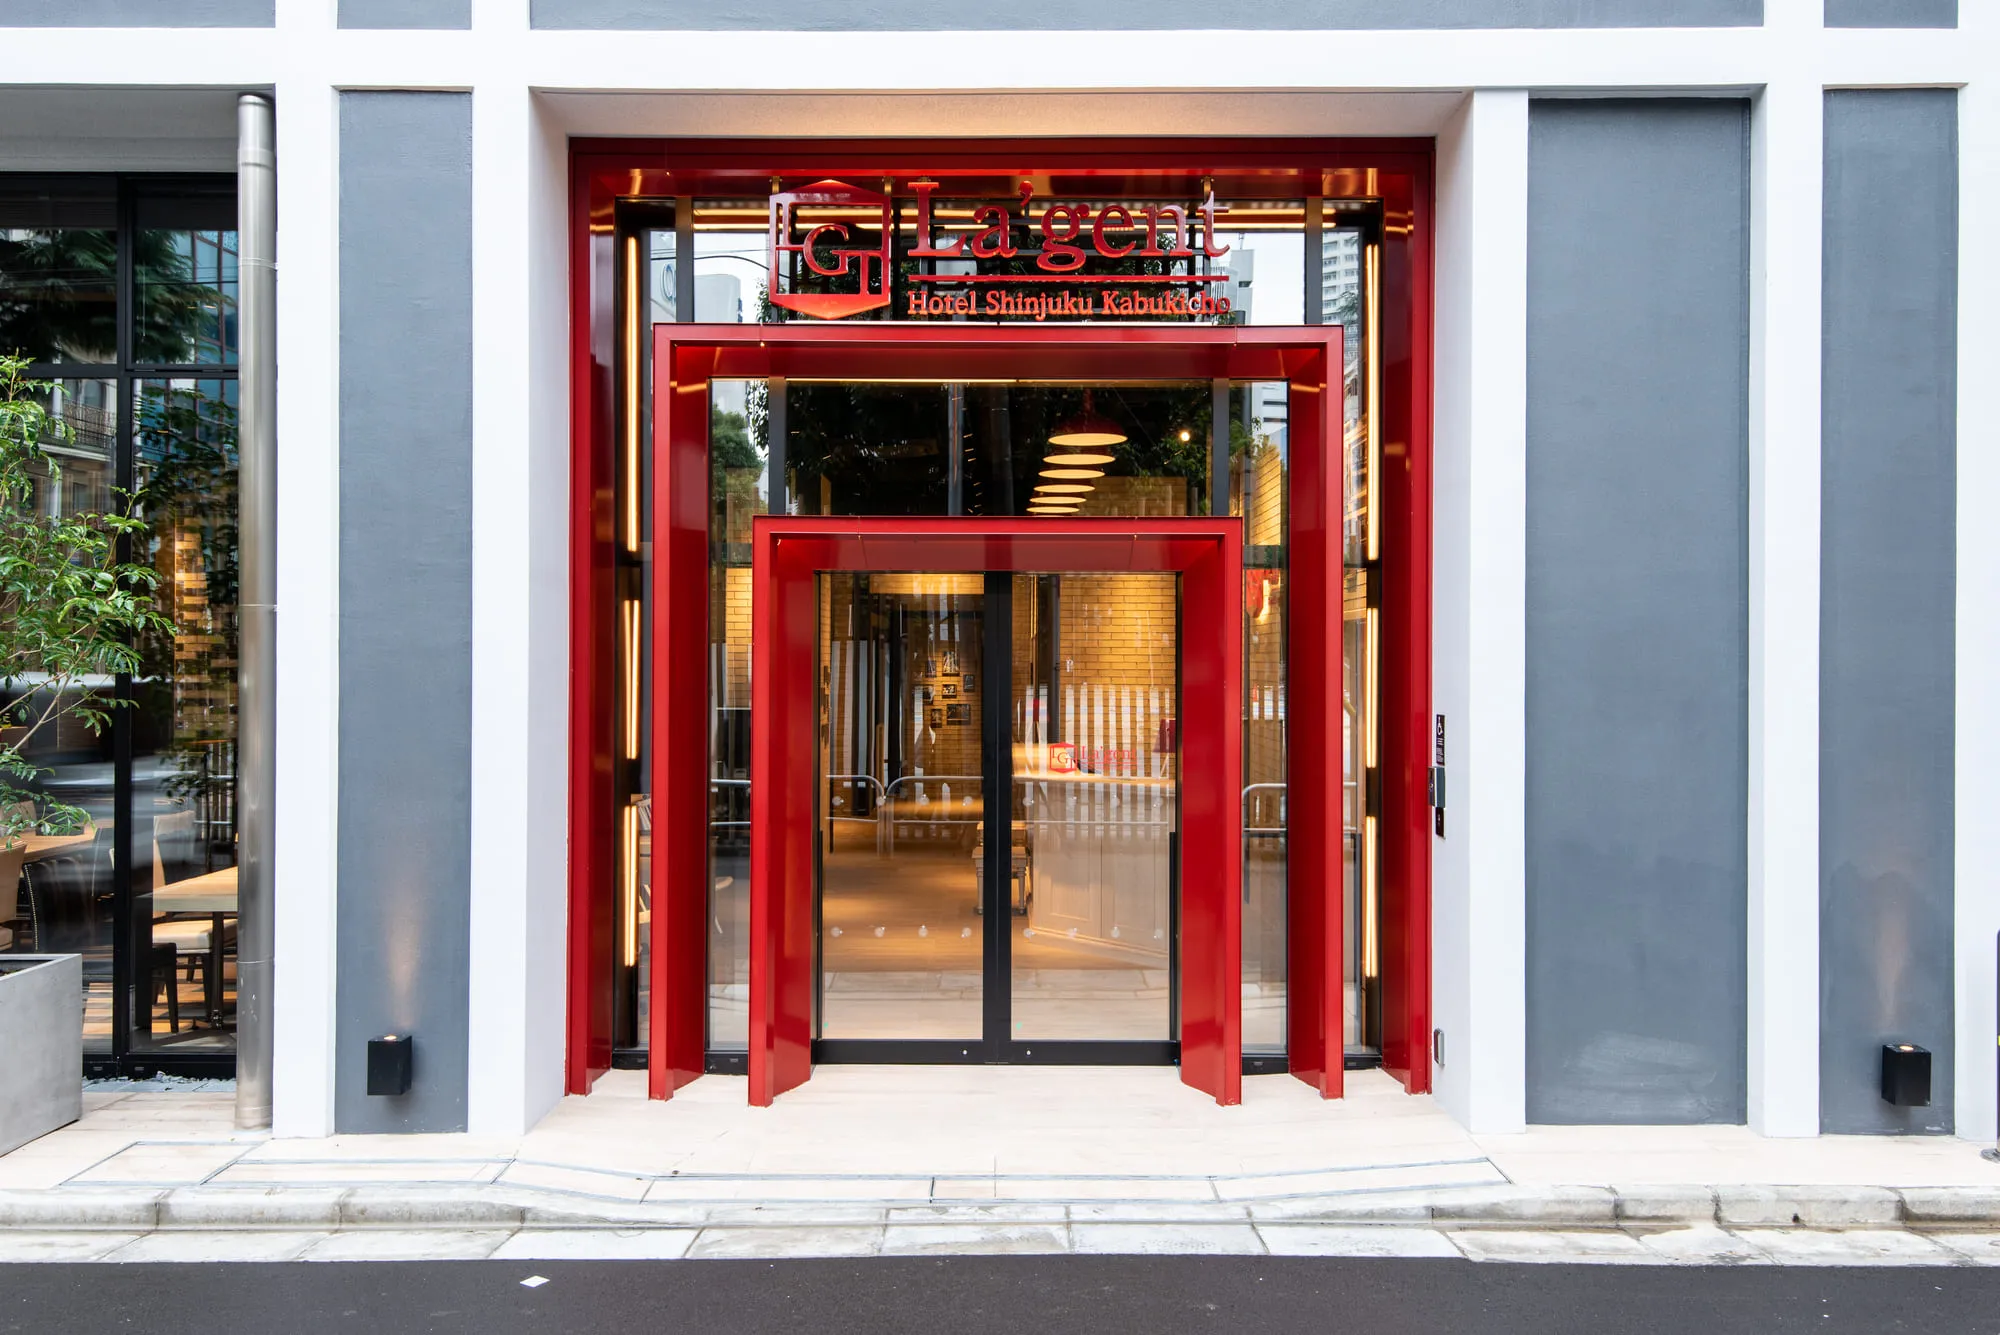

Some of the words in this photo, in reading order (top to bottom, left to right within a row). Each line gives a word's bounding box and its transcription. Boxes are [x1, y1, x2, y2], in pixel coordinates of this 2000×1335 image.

[907, 180, 1230, 272] La'gent
[907, 290, 978, 315] Hotel
[985, 290, 1094, 321] Shinjuku
[1101, 290, 1231, 315] Kabukicho
